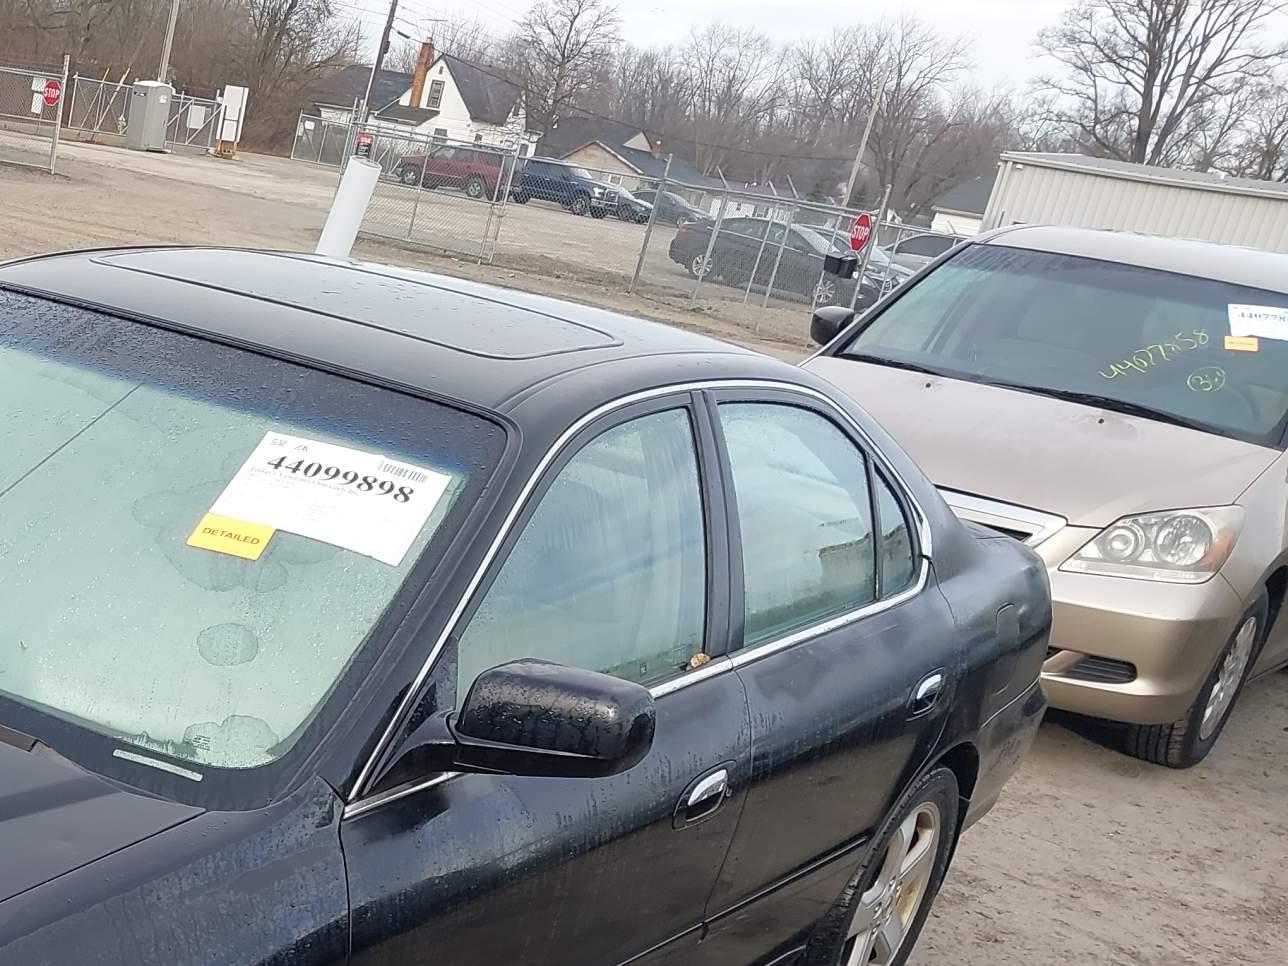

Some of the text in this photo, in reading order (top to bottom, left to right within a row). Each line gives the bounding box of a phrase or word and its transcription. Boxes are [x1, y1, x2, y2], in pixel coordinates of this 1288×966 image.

[44, 87, 60, 98] STOP
[852, 224, 869, 241] STOP
[266, 455, 415, 503] 44099898
[202, 527, 260, 545] DETAILED
